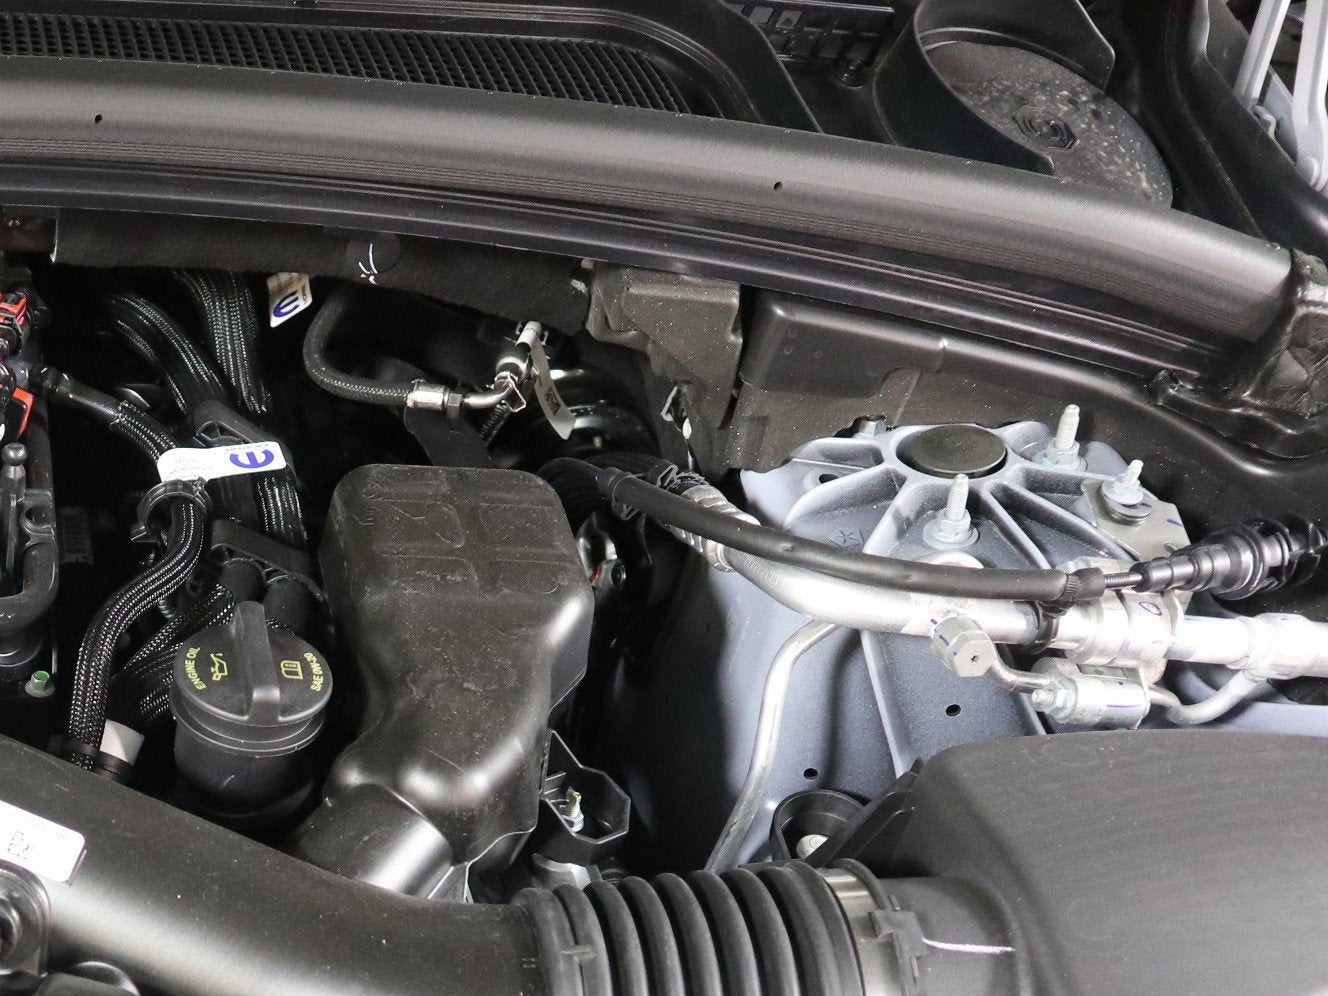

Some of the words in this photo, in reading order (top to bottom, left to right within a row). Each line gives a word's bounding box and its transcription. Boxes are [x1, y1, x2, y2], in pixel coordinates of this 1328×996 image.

[186, 646, 201, 659] OIL
[304, 652, 323, 675] 0W-20
[185, 659, 207, 690] ENGINE
[310, 675, 324, 692] SAE
